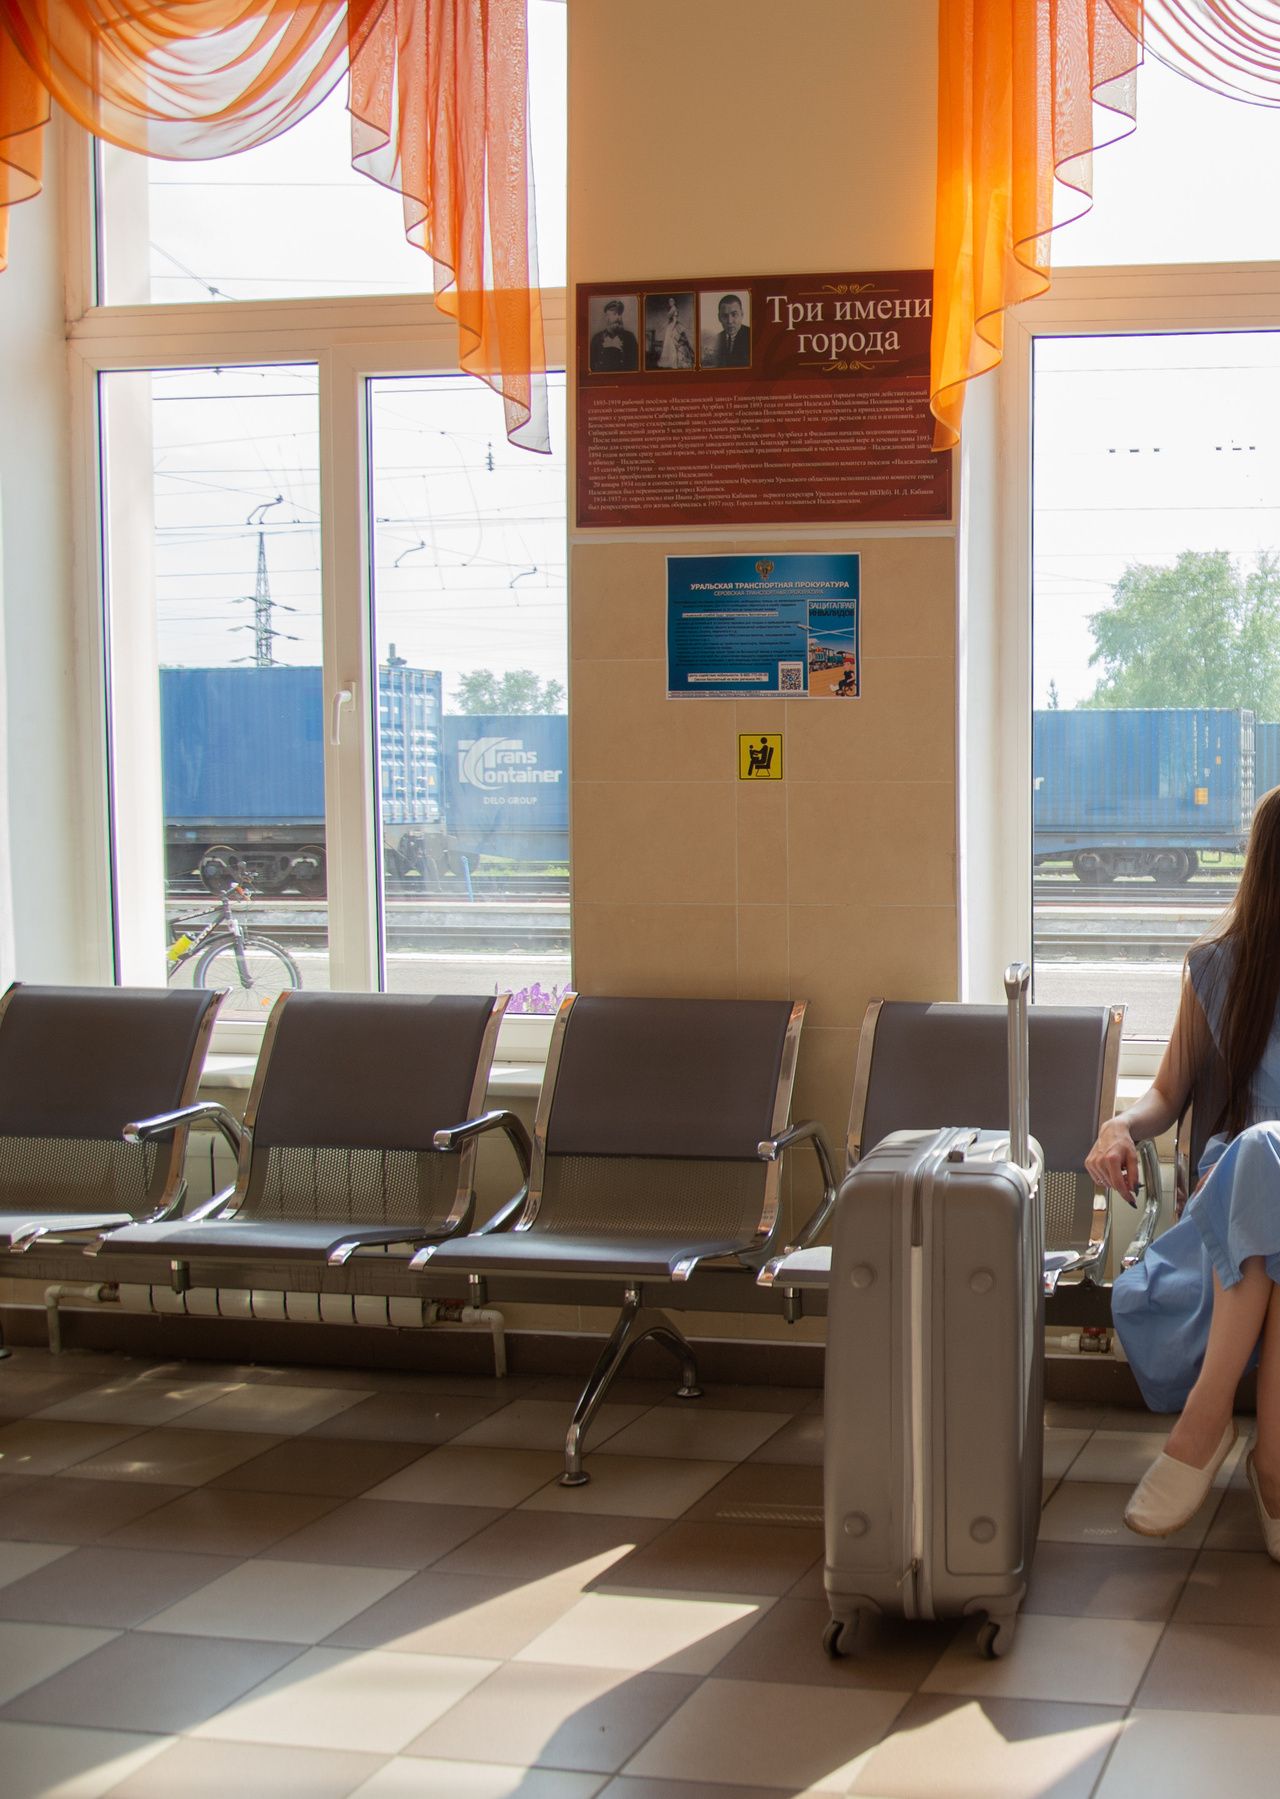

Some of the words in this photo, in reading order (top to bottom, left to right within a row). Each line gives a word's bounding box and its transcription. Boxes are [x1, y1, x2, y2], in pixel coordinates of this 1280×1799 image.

[766, 295, 824, 331] Три
[834, 298, 932, 321] имени
[798, 330, 901, 361] города
[690, 582, 733, 591] УРАЛЬСКАЯ
[735, 581, 793, 589] ТРАНСПОРТНАЯ
[484, 797, 505, 805] DELO
[508, 797, 537, 805] GROUP
